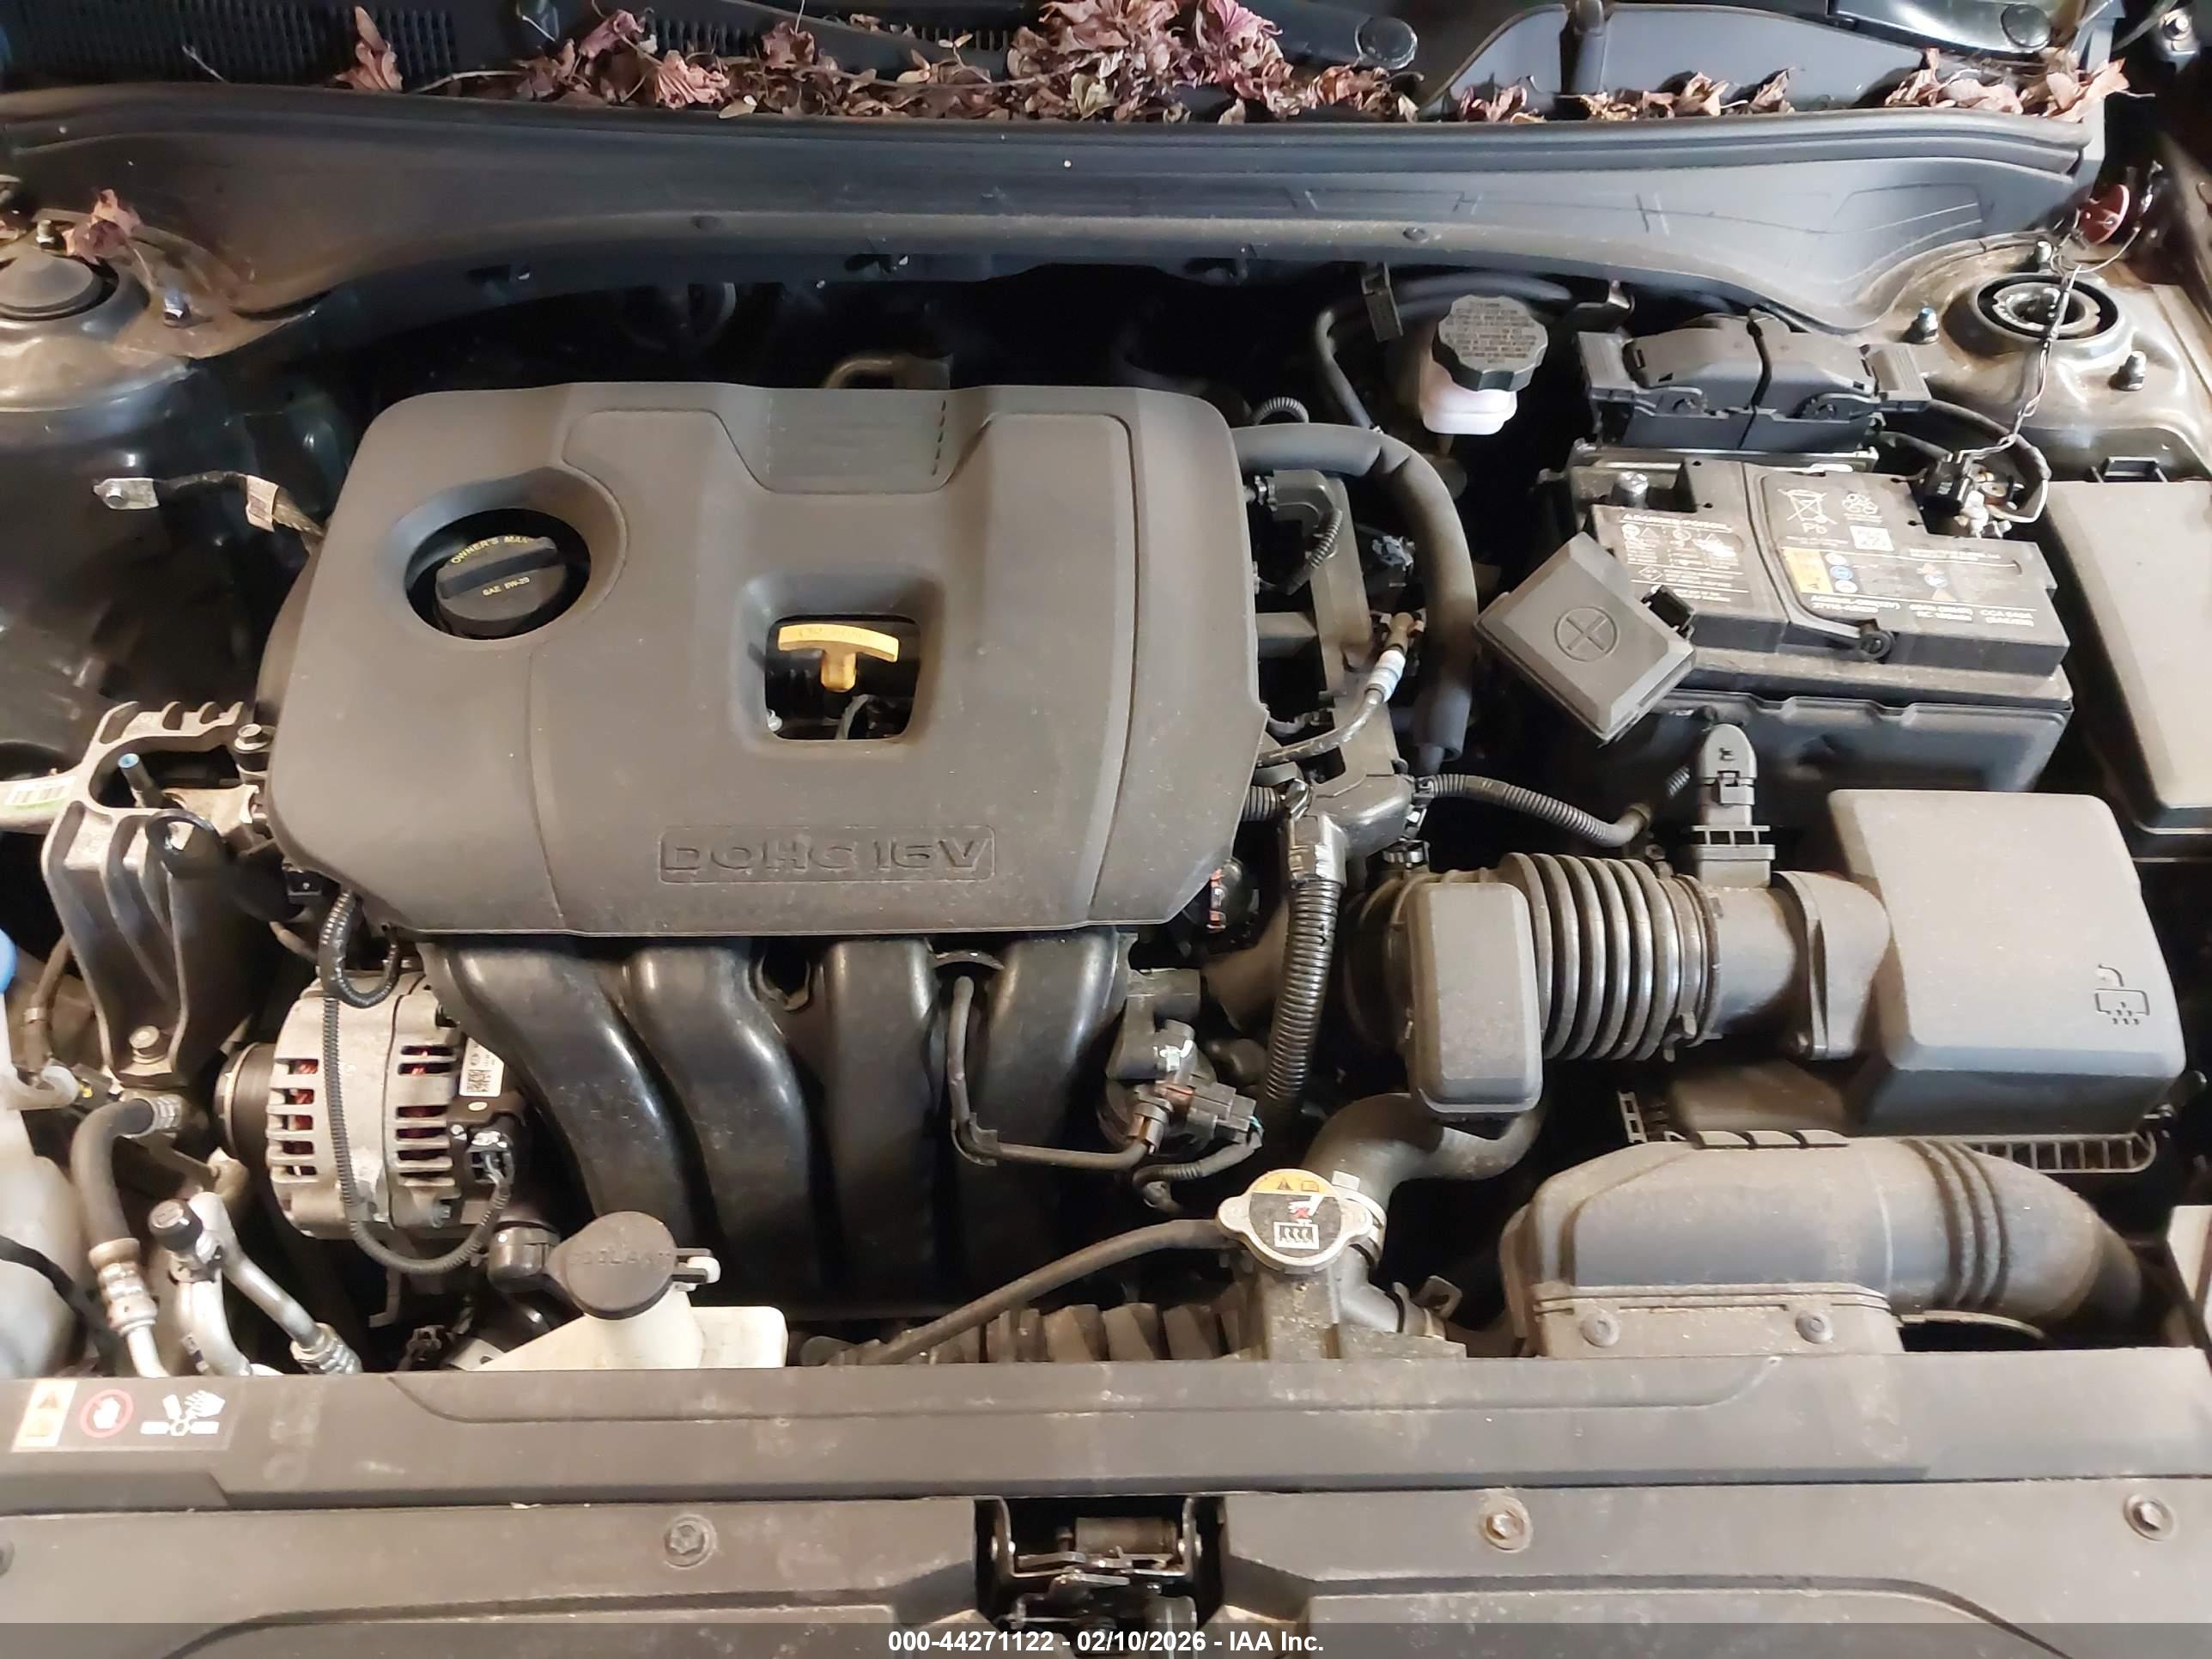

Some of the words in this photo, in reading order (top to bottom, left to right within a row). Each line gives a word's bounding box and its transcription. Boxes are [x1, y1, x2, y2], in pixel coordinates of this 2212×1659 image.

[1802, 522, 1827, 534] Pb
[450, 535, 499, 564] OWNER'S
[662, 839, 854, 872] DOHC
[875, 837, 988, 870] 16V
